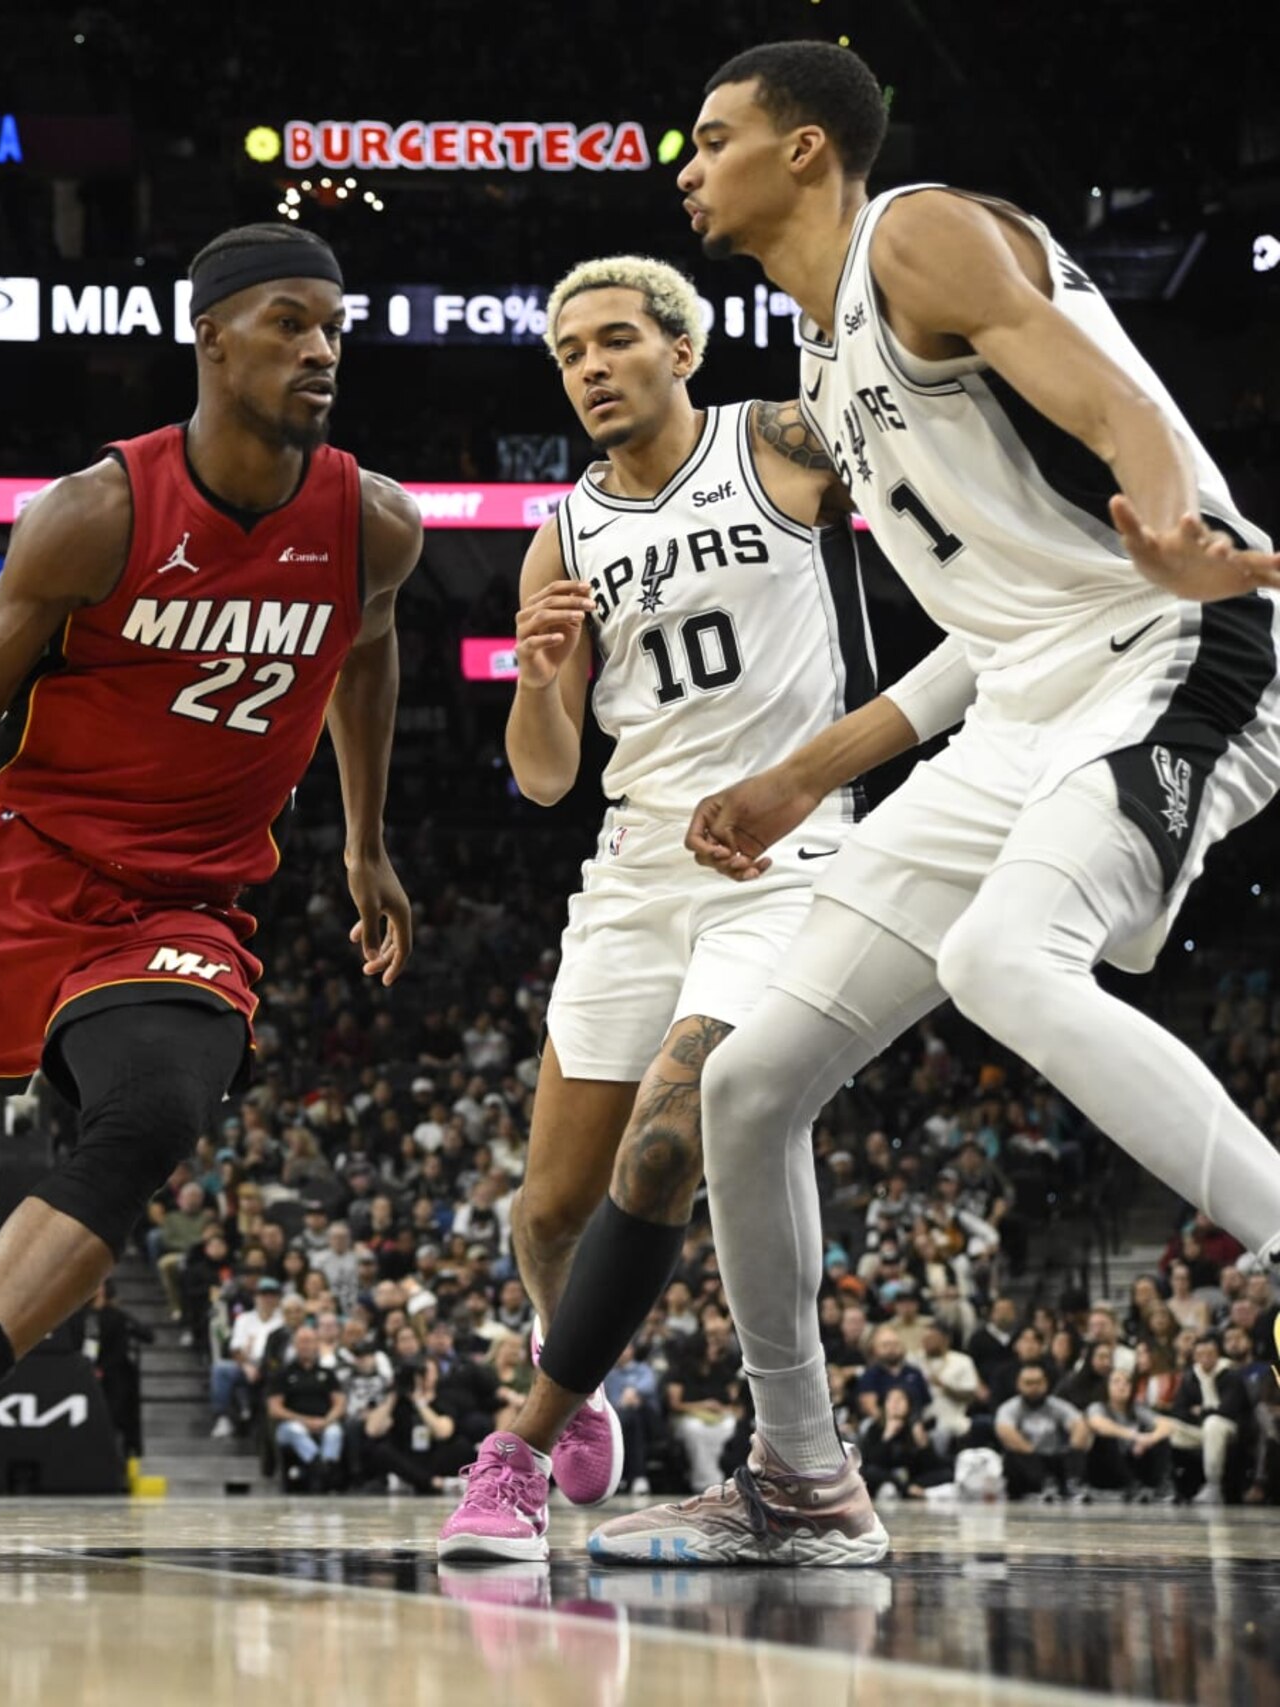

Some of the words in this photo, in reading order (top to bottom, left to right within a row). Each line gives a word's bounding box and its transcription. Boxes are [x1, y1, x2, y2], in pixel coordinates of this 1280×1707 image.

[284, 120, 651, 170] BURGERTECA
[52, 285, 162, 335] MIA
[434, 295, 548, 334] FG%
[886, 477, 967, 568] 1
[121, 598, 333, 656] MIAMI
[639, 606, 745, 707] 10
[170, 657, 296, 734] 22
